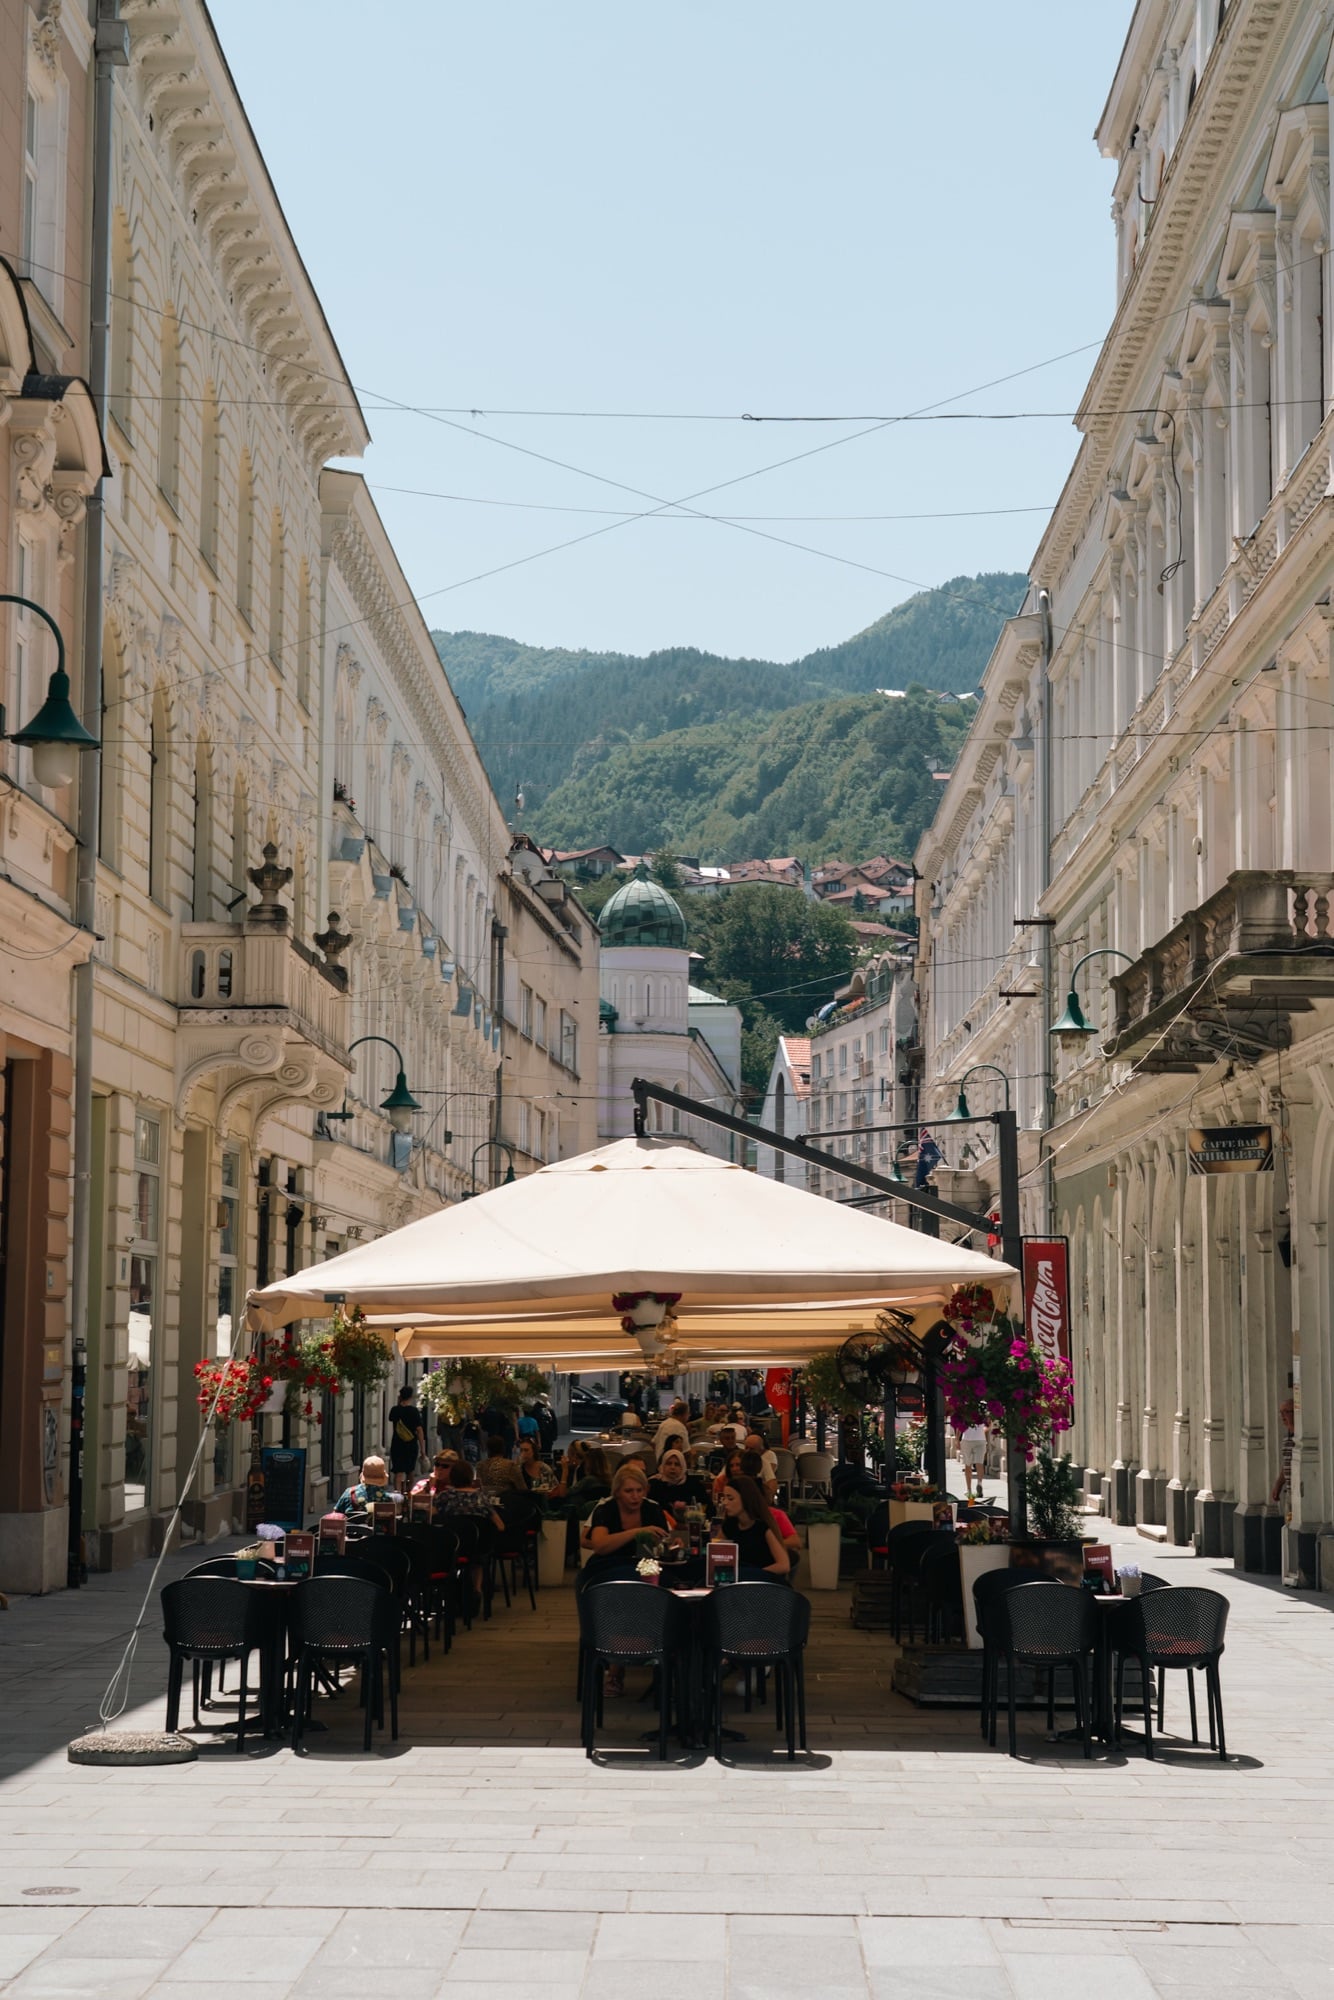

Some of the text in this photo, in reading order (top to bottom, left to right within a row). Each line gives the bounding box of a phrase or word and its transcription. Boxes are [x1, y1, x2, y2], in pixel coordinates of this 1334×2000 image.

[1202, 1138, 1259, 1150] CAFFE BAR
[1195, 1149, 1266, 1162] THRILLER
[1031, 1266, 1062, 1361] oca-Cola
